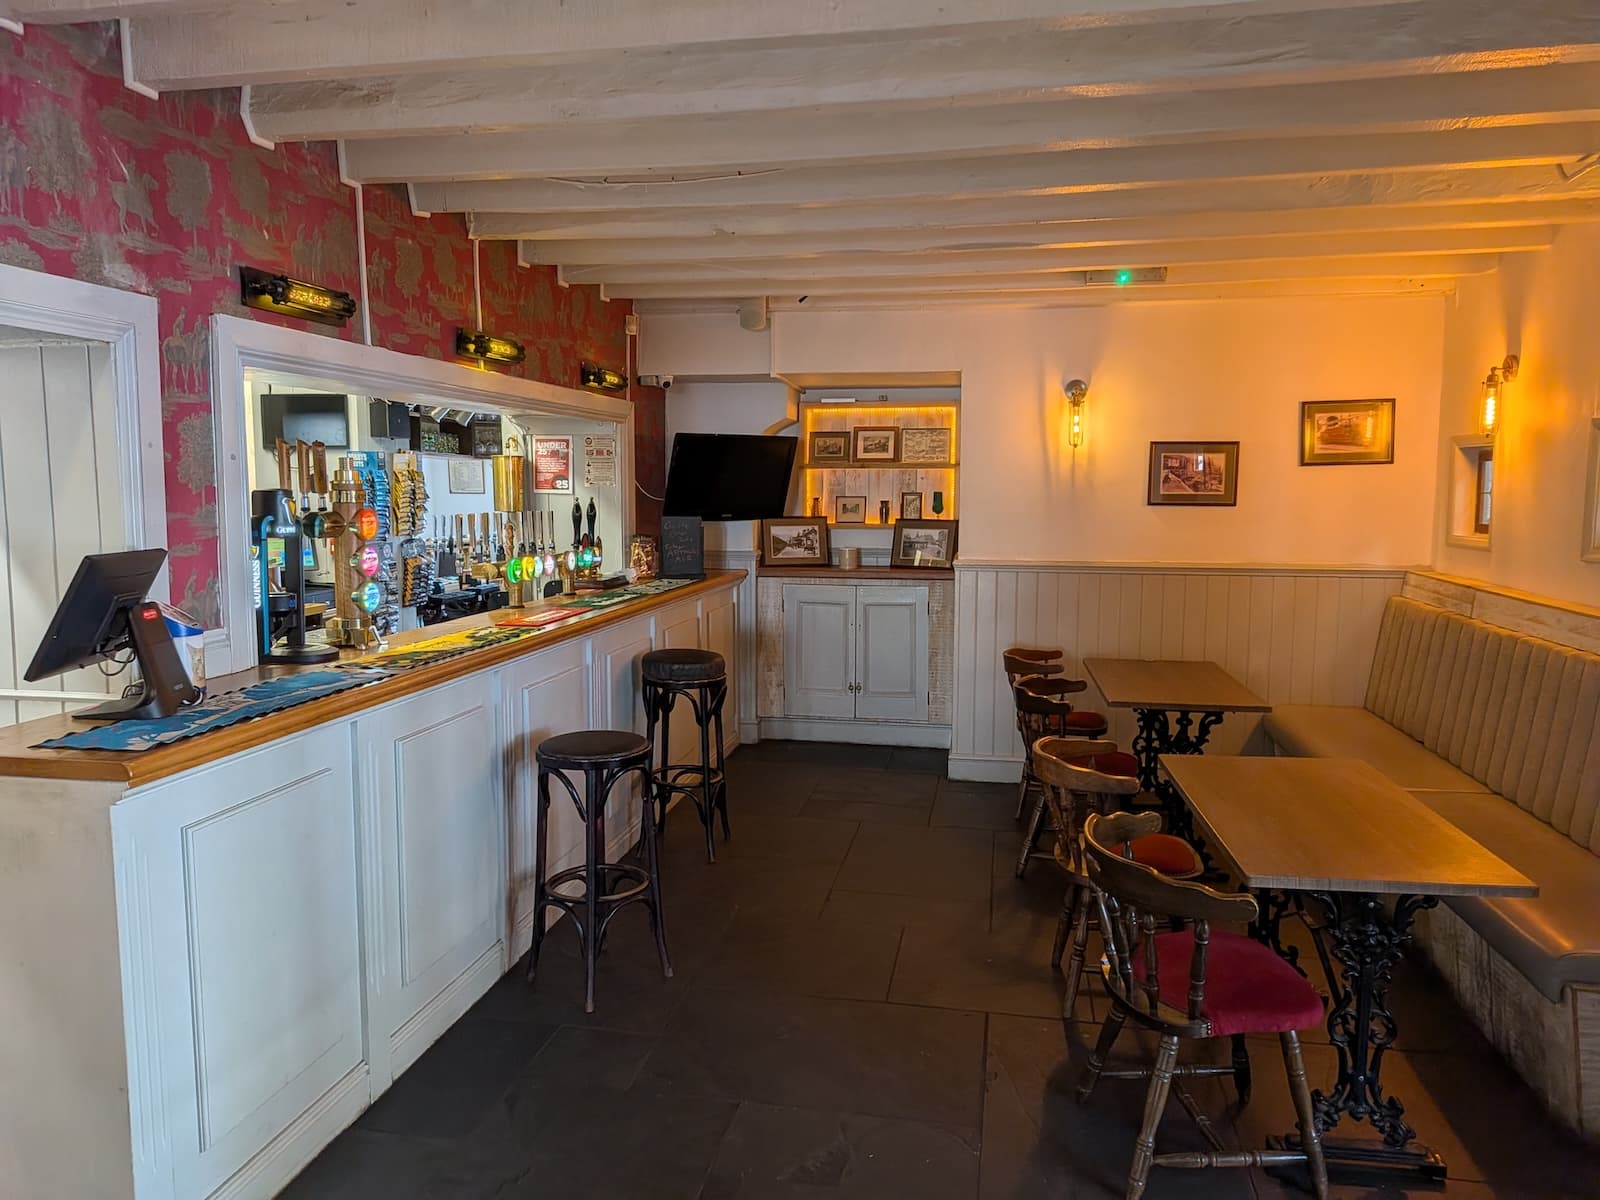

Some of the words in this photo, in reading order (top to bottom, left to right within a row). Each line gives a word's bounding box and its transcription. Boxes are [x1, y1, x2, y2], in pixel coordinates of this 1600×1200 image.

[537, 440, 567, 449] UNDER
[556, 479, 569, 488] 25
[252, 559, 262, 609] GUINNESS
